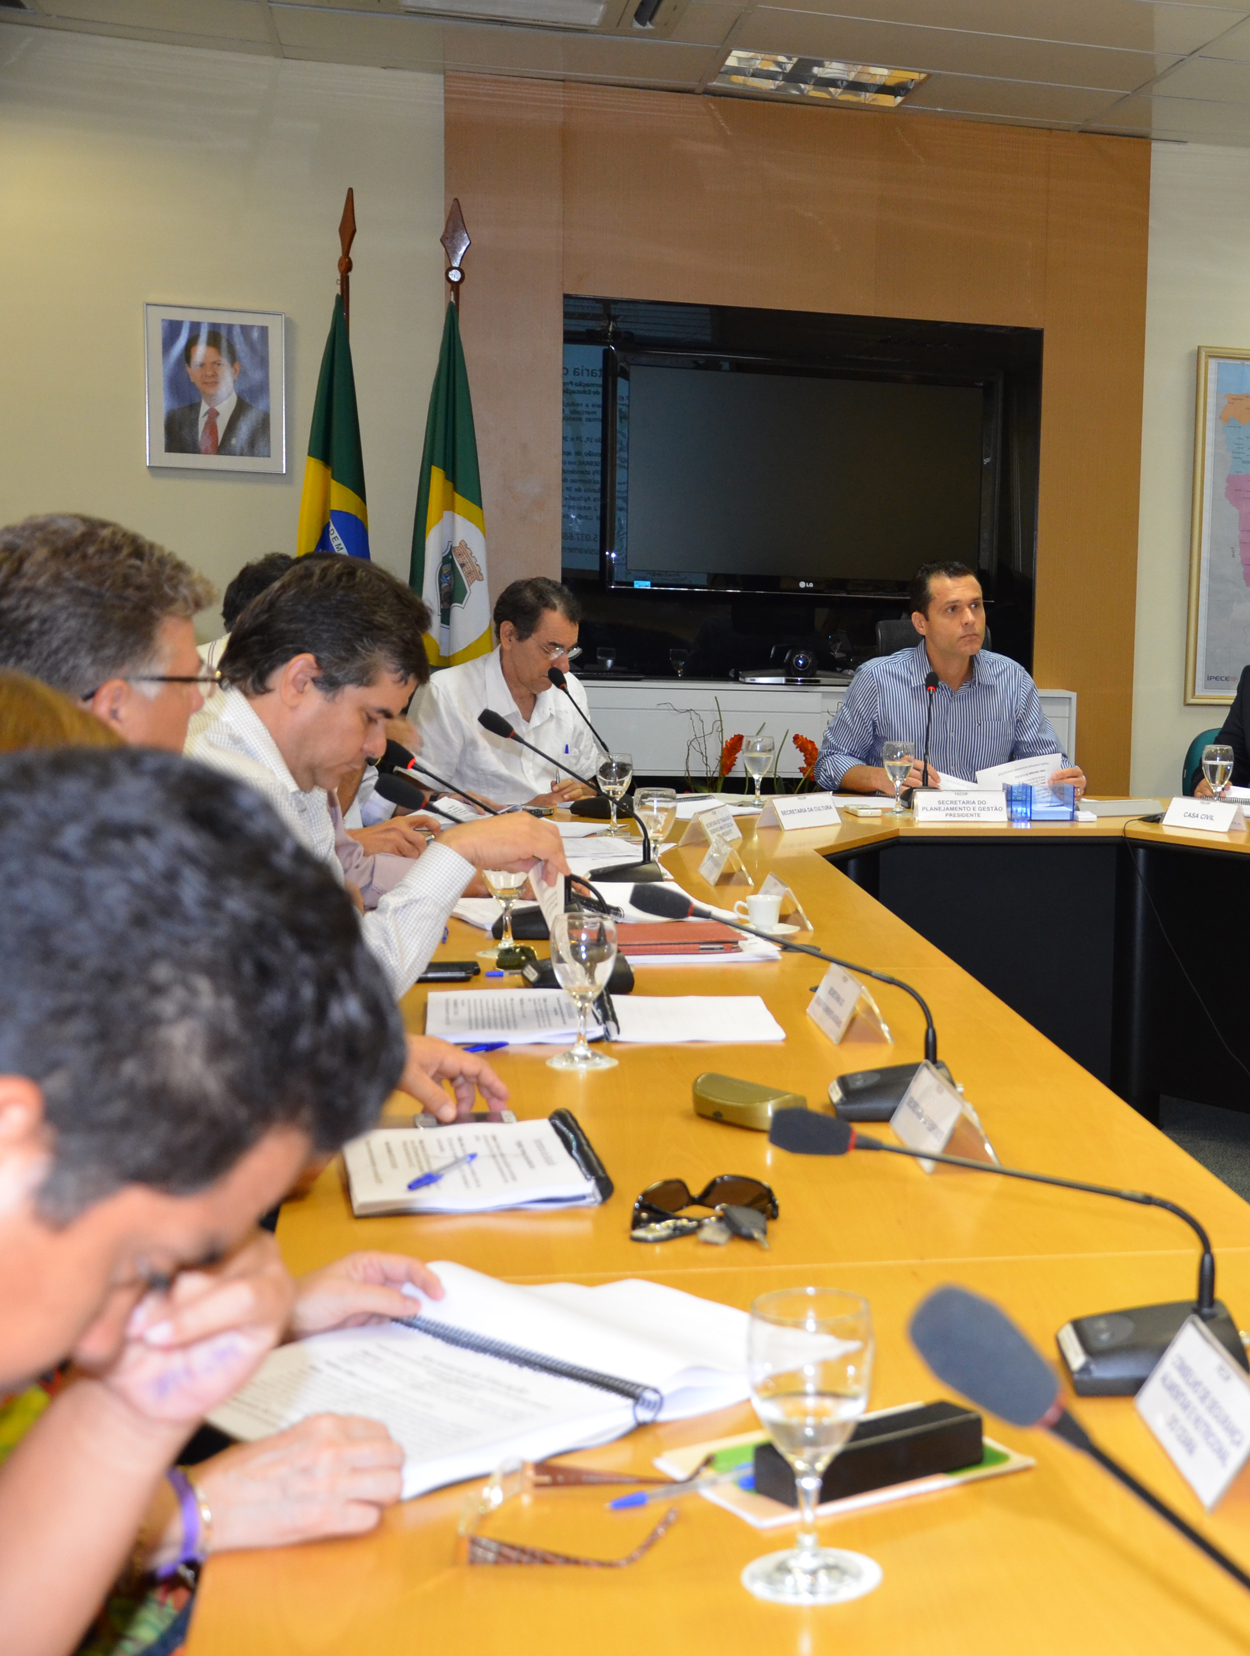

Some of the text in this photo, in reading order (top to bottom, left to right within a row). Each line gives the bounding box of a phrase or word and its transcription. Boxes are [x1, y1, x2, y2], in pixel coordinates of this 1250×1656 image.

[329, 527, 344, 552] DEM
[780, 807, 807, 816] SECRETARIA
[1183, 811, 1215, 821] CASA CIVIL
